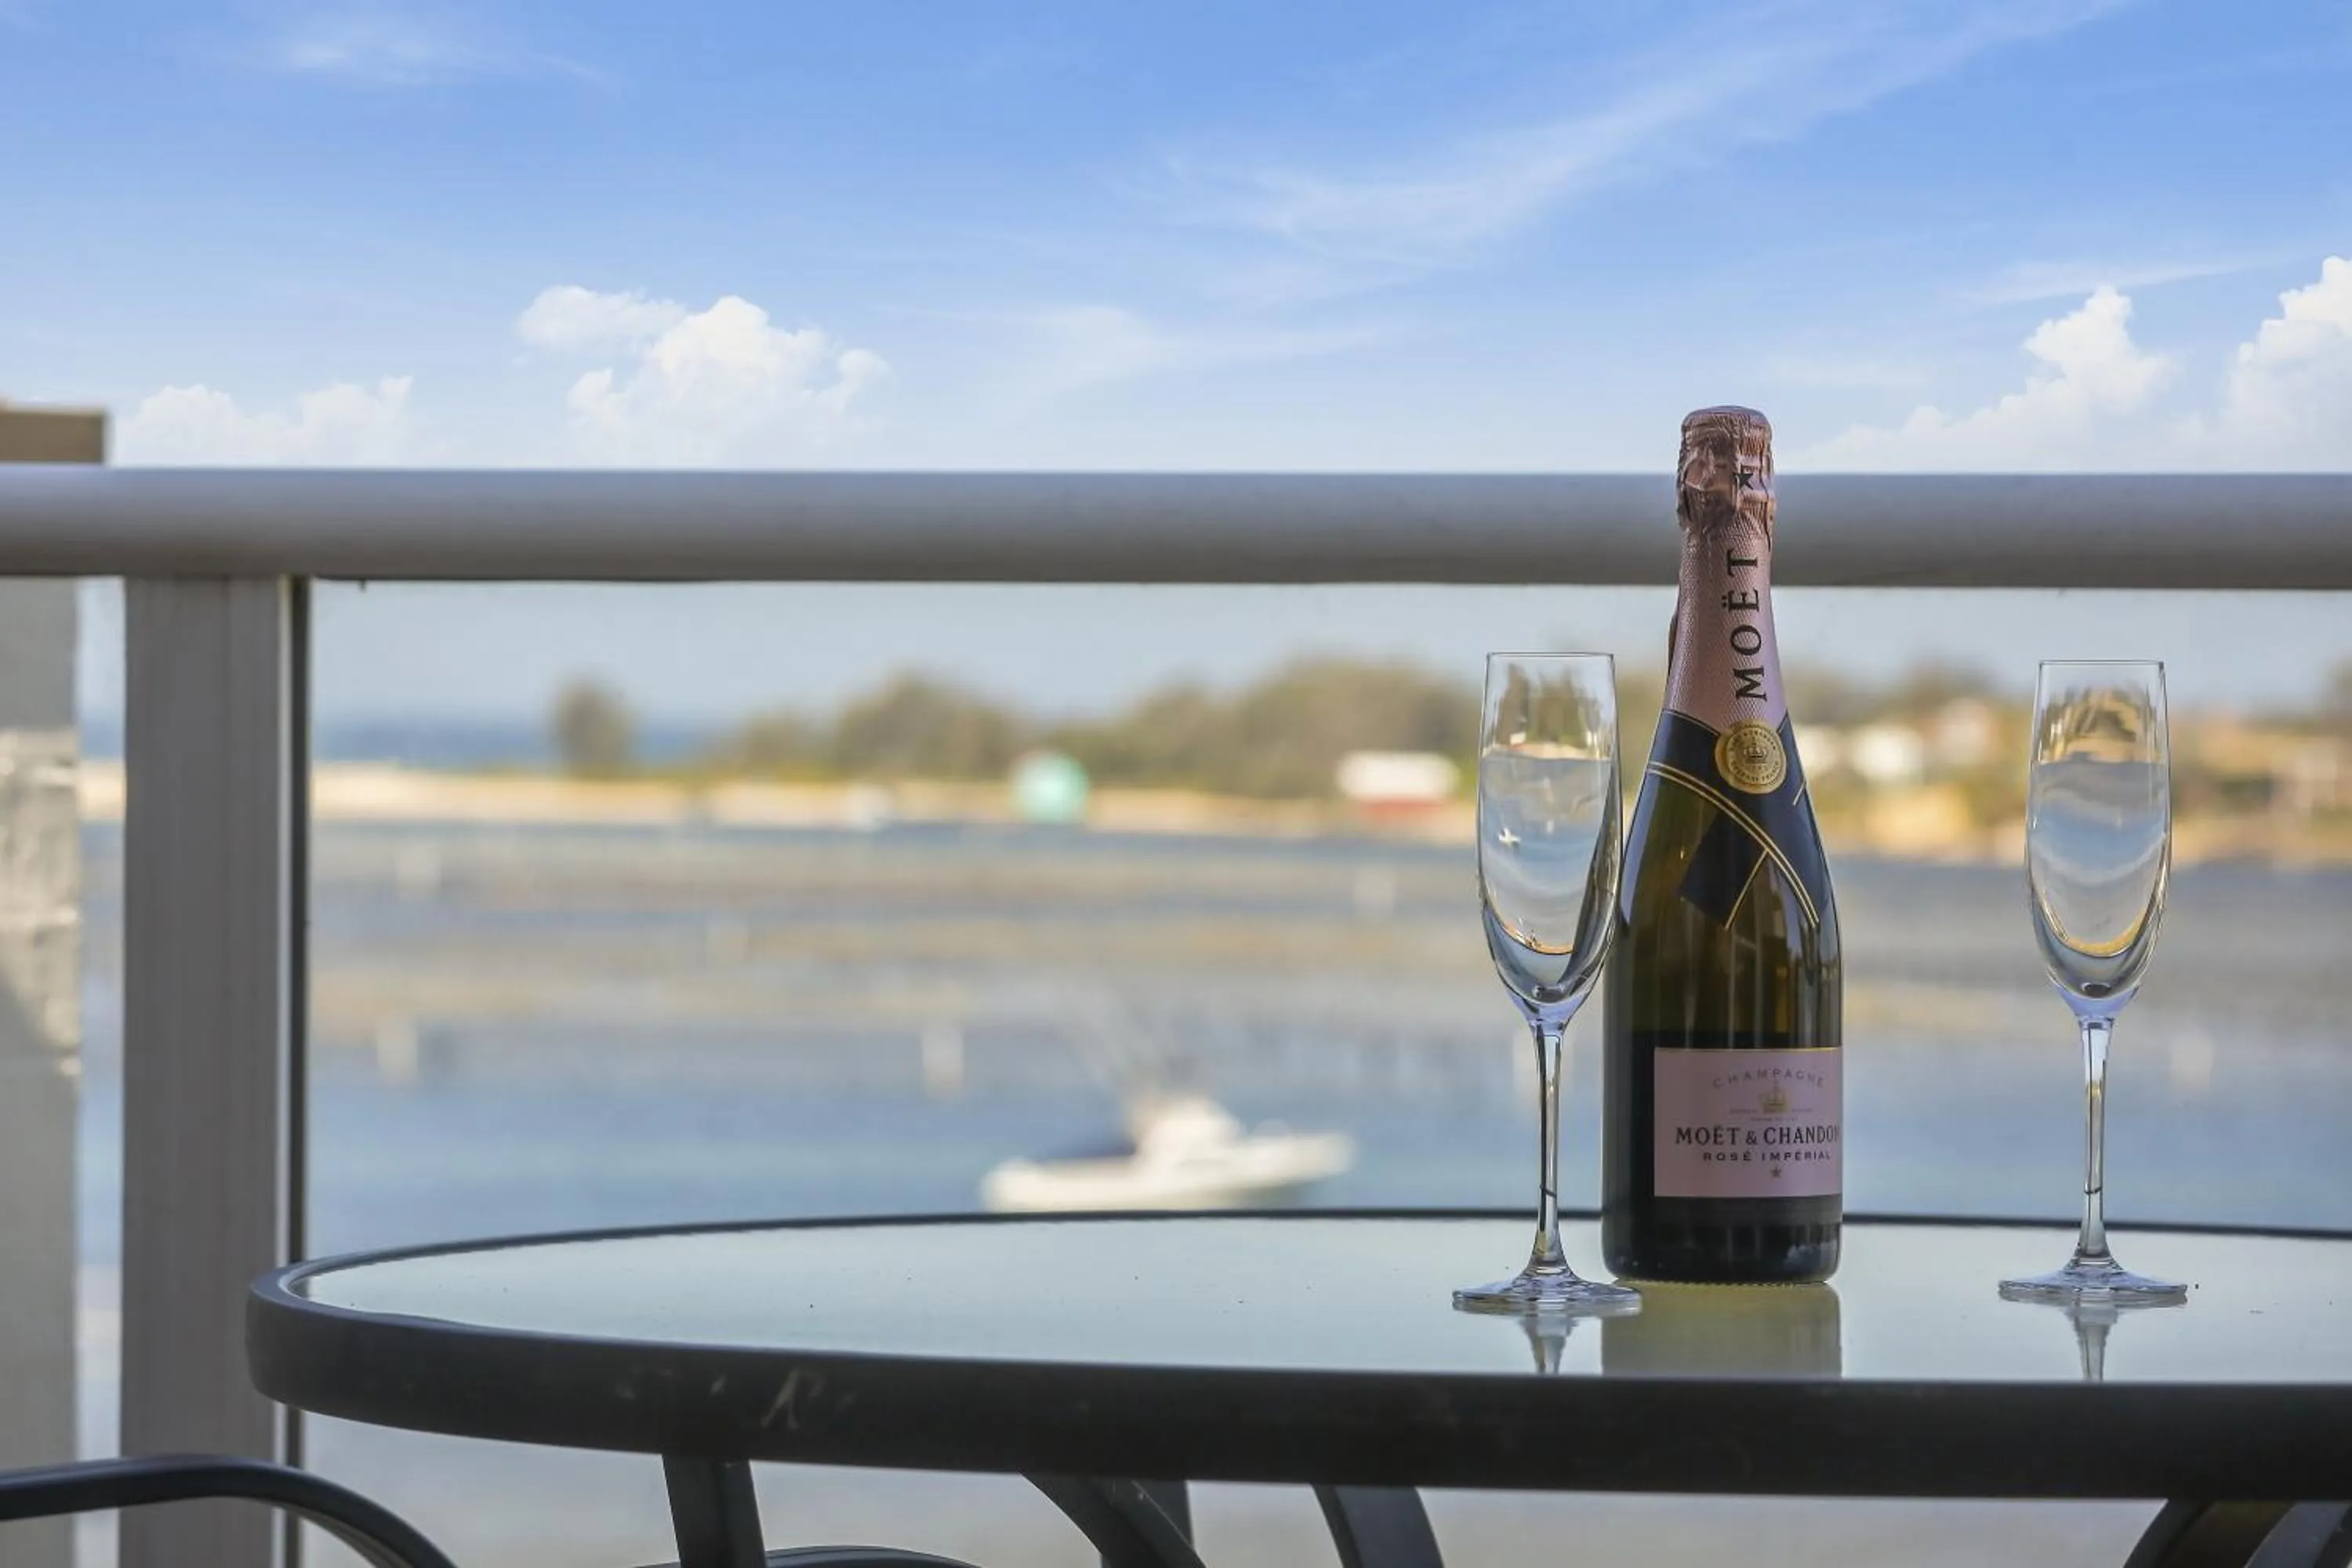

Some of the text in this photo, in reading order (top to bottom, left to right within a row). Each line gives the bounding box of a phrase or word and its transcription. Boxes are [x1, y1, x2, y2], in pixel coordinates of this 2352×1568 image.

[1722, 550, 1767, 702] MOËT
[1712, 1068, 1824, 1089] CHAMPAGNE
[1675, 1124, 1741, 1145] MOËT
[1745, 1130, 1757, 1145] &
[1703, 1149, 1751, 1161] ROSÉ
